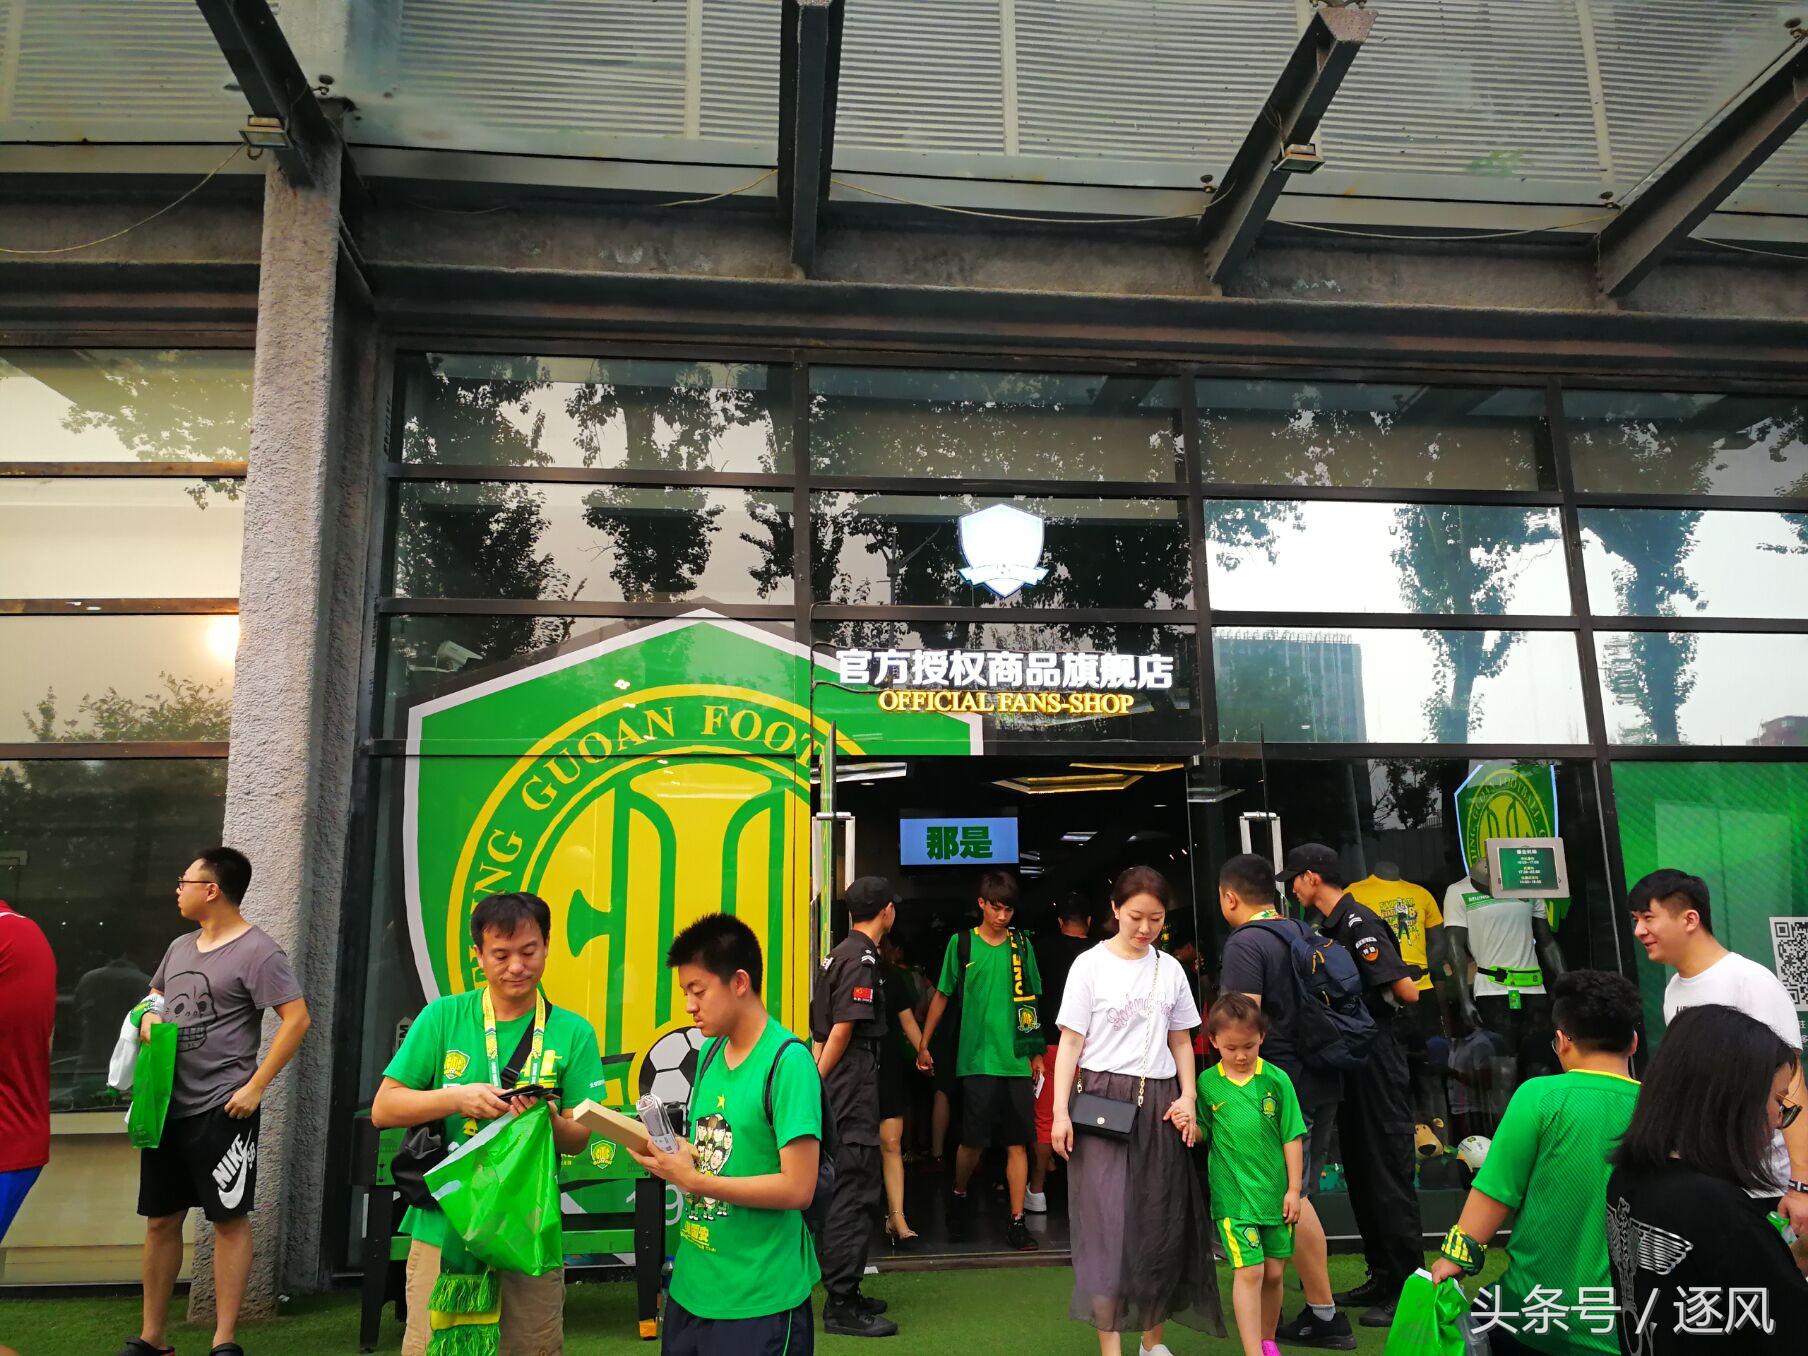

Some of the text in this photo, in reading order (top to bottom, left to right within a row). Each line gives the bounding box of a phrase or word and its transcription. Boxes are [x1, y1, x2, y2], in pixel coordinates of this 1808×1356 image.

[837, 648, 1174, 690] 官方授权商品旗舰店
[878, 689, 1135, 715] OFFICIAL FANS-SHOP
[521, 706, 676, 811] GUOAN
[926, 826, 993, 860] 那是
[211, 1132, 244, 1191] NIKE
